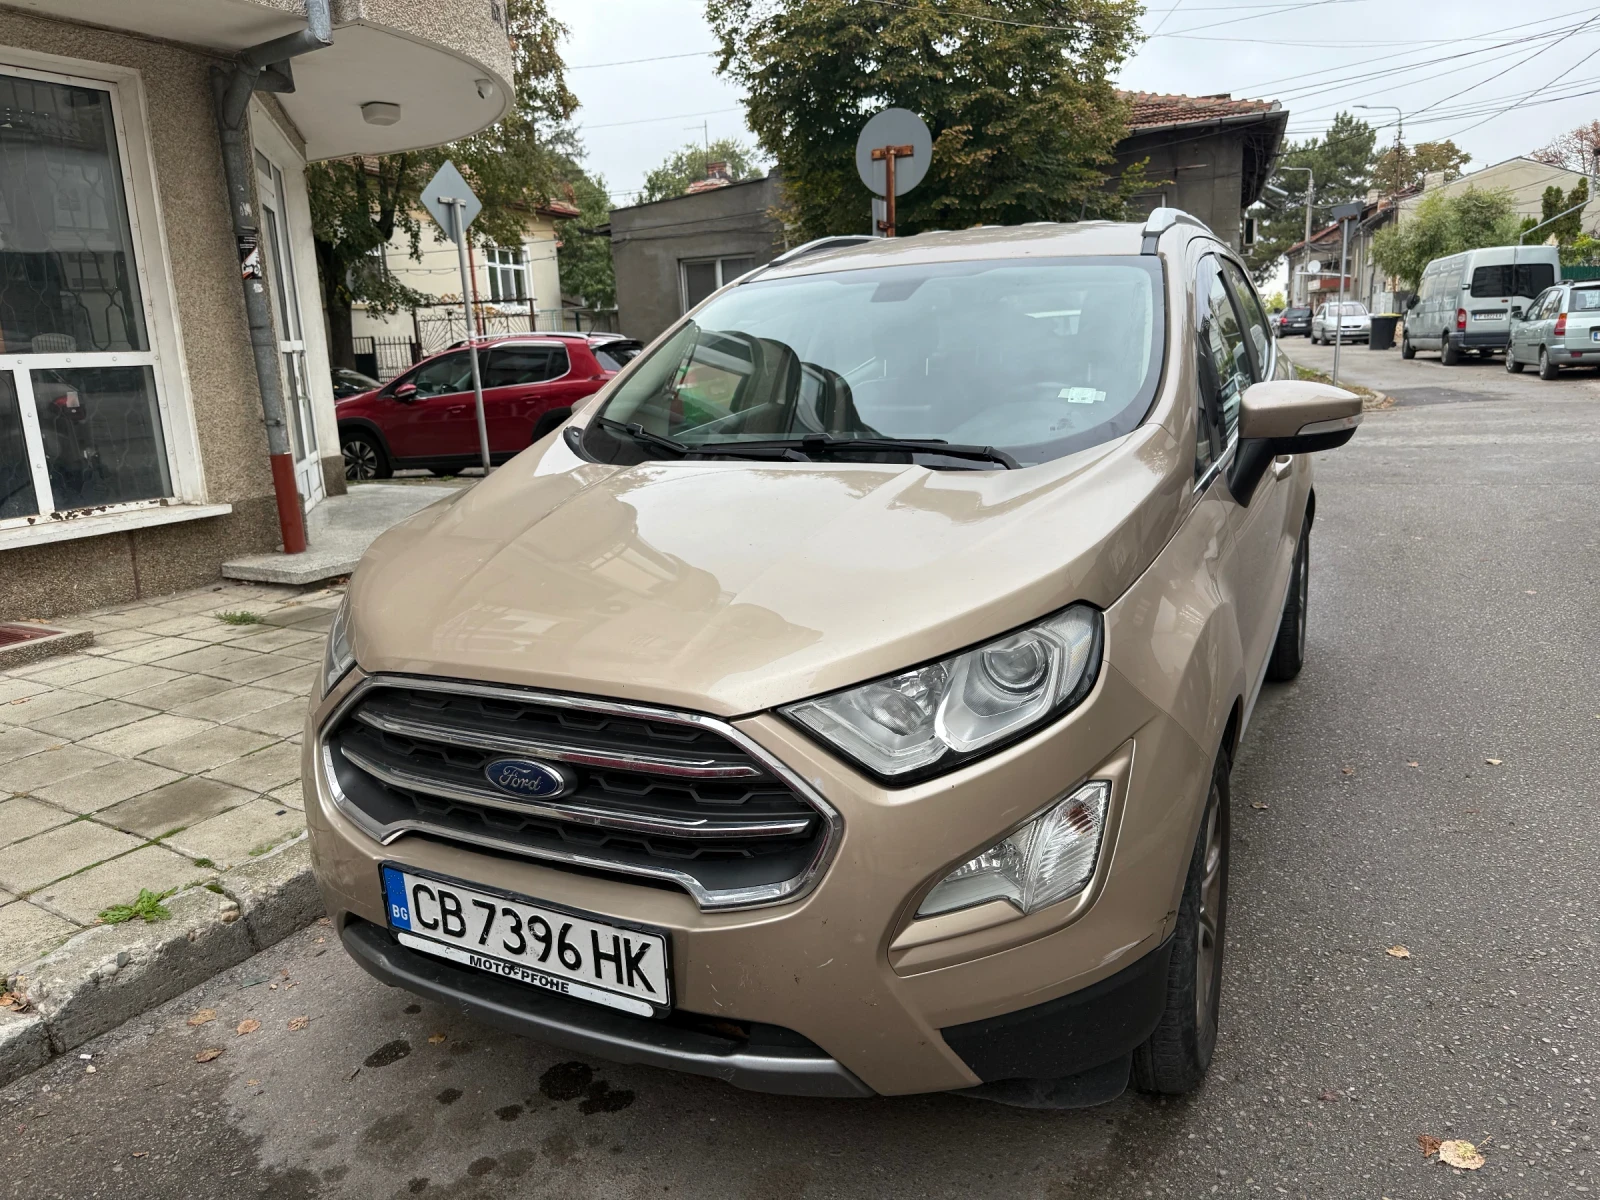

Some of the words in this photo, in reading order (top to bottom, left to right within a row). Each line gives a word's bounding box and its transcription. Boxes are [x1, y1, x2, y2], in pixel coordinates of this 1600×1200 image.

[499, 765, 542, 791] Ford
[392, 904, 409, 921] BG
[412, 884, 467, 939] CB
[472, 898, 583, 971] 7396
[590, 929, 656, 994] HK
